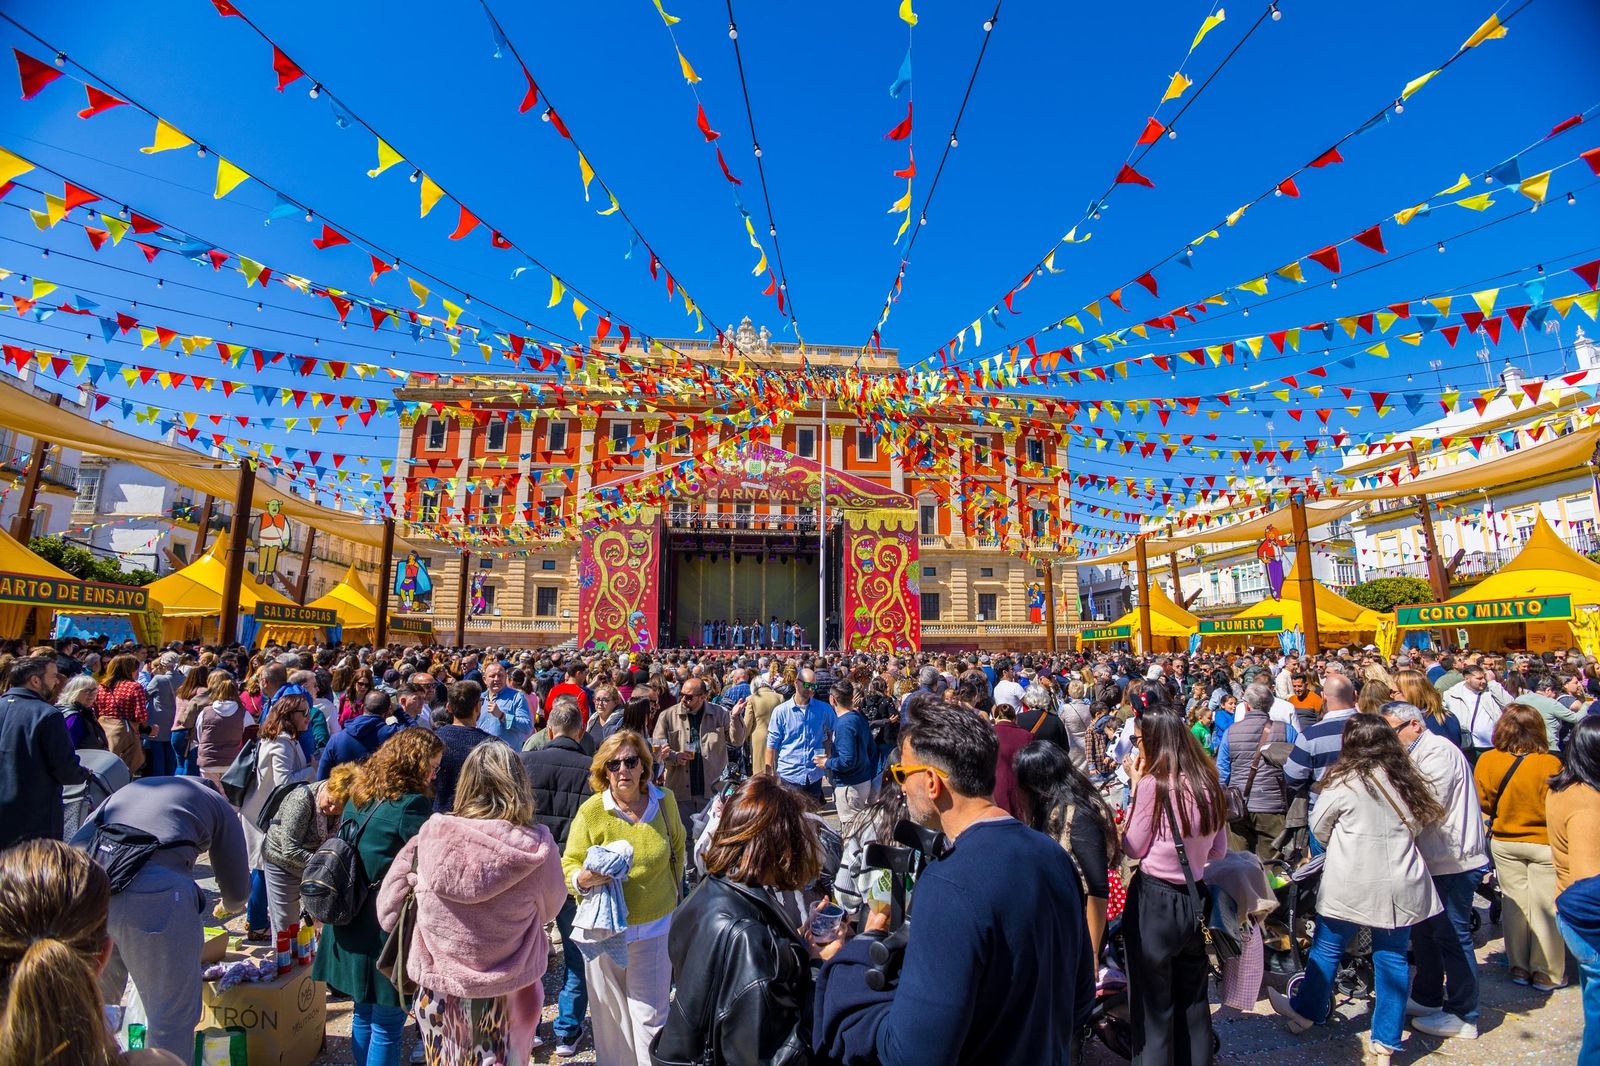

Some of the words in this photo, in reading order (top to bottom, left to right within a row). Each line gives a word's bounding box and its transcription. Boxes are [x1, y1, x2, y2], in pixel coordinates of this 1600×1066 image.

[707, 487, 801, 501] CARNAVAL
[56, 584, 79, 600] DE
[83, 586, 145, 607] ENSAYO
[263, 605, 281, 617] SAL
[284, 607, 296, 618] DE
[299, 609, 331, 622] COPLAS
[1419, 604, 1469, 621] CORO
[1475, 600, 1542, 618] MIXTO
[1214, 619, 1264, 631] PLUMERO
